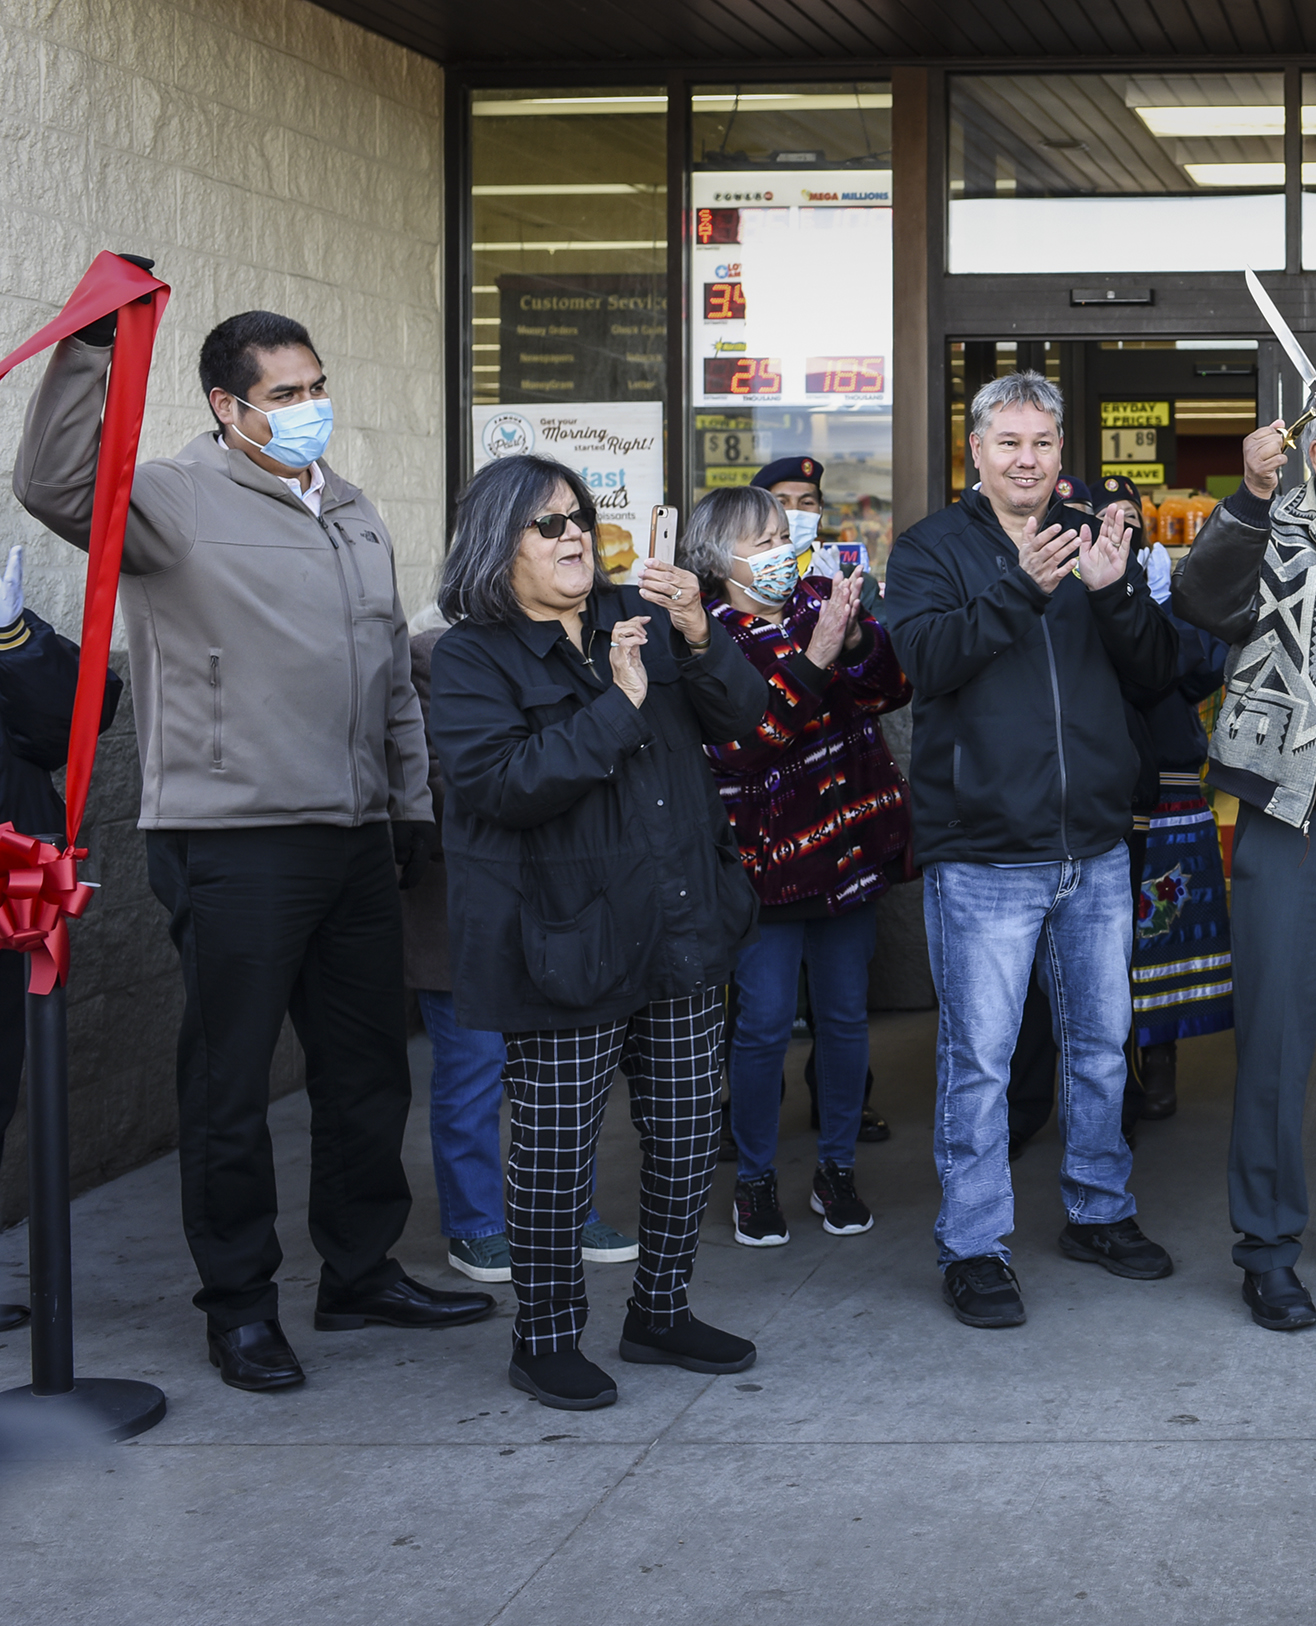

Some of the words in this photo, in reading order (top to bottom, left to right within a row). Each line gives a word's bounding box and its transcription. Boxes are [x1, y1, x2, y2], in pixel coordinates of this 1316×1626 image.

[809, 192, 838, 201] MEGA
[841, 192, 889, 201] MILLIONS
[520, 295, 601, 311] Customer
[730, 358, 781, 394] 25
[822, 358, 883, 392] 185
[558, 419, 578, 428] your
[1113, 416, 1162, 427] PRICES
[542, 426, 609, 442] Morning
[574, 443, 605, 452] started
[607, 436, 655, 455] Right!
[1127, 470, 1159, 478] SAVE
